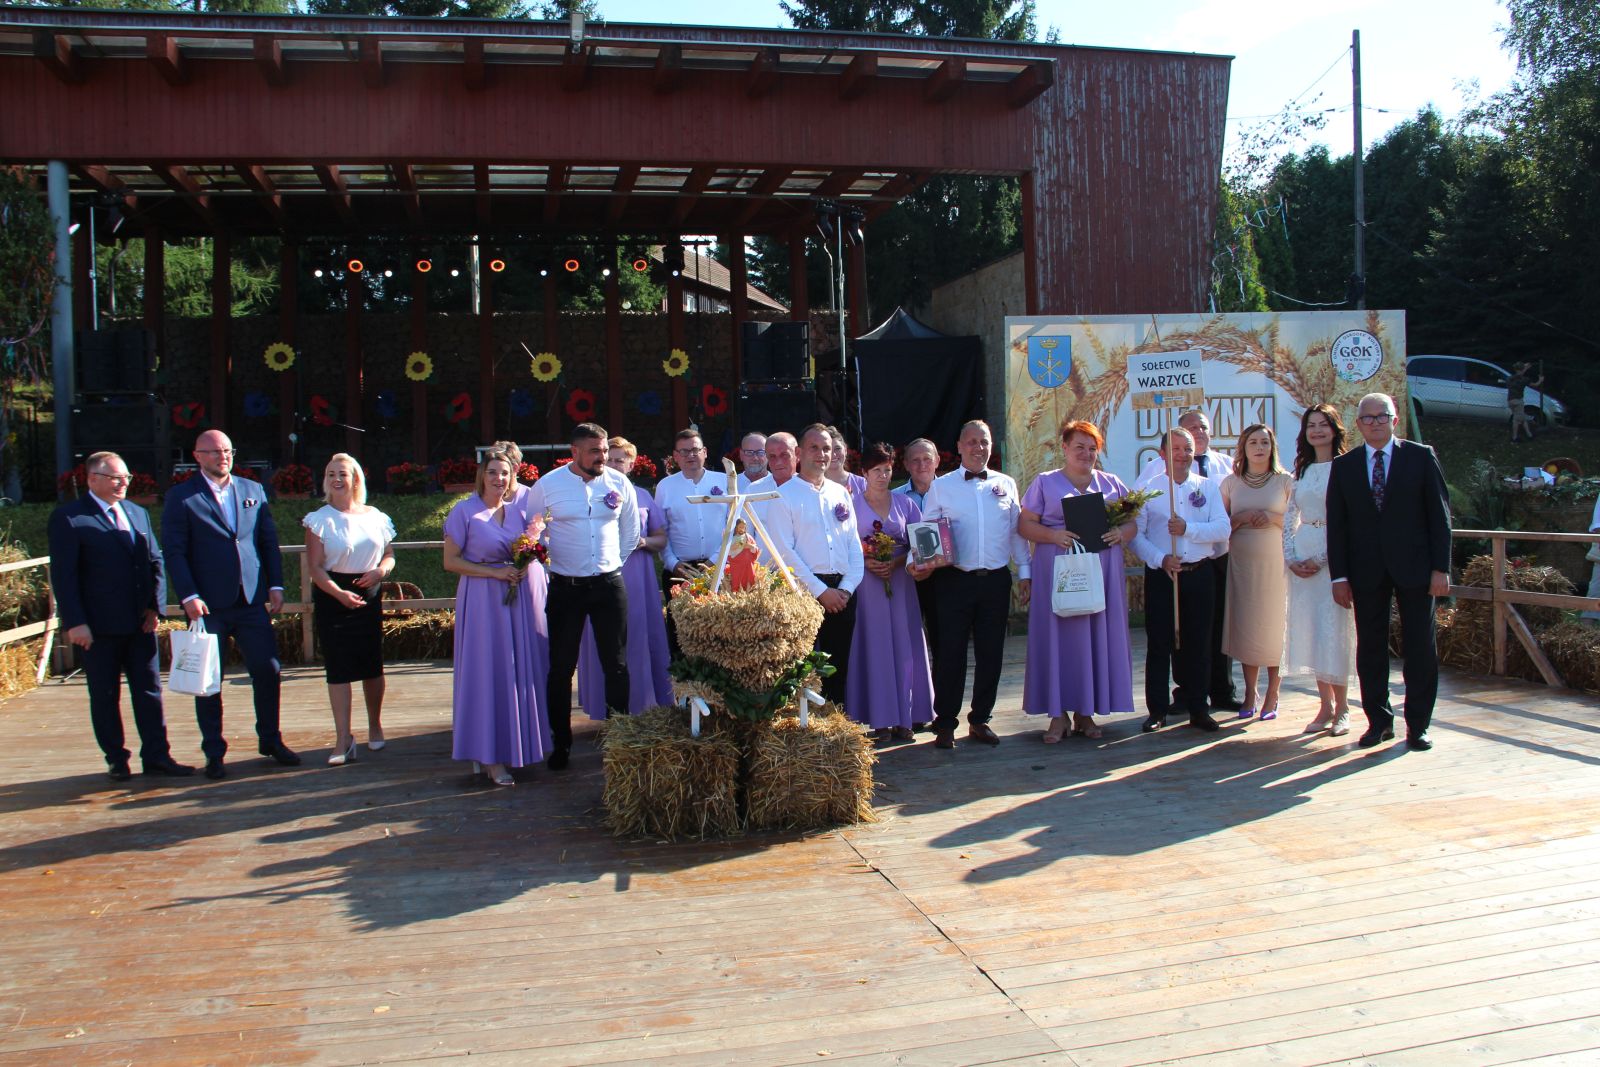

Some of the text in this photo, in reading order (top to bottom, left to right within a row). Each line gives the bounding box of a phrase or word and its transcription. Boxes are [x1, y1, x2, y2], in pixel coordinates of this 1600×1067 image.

[1340, 346, 1372, 357] GOK
[1142, 359, 1190, 371] SOŁECTWO
[1137, 373, 1197, 388] WARZYCE
